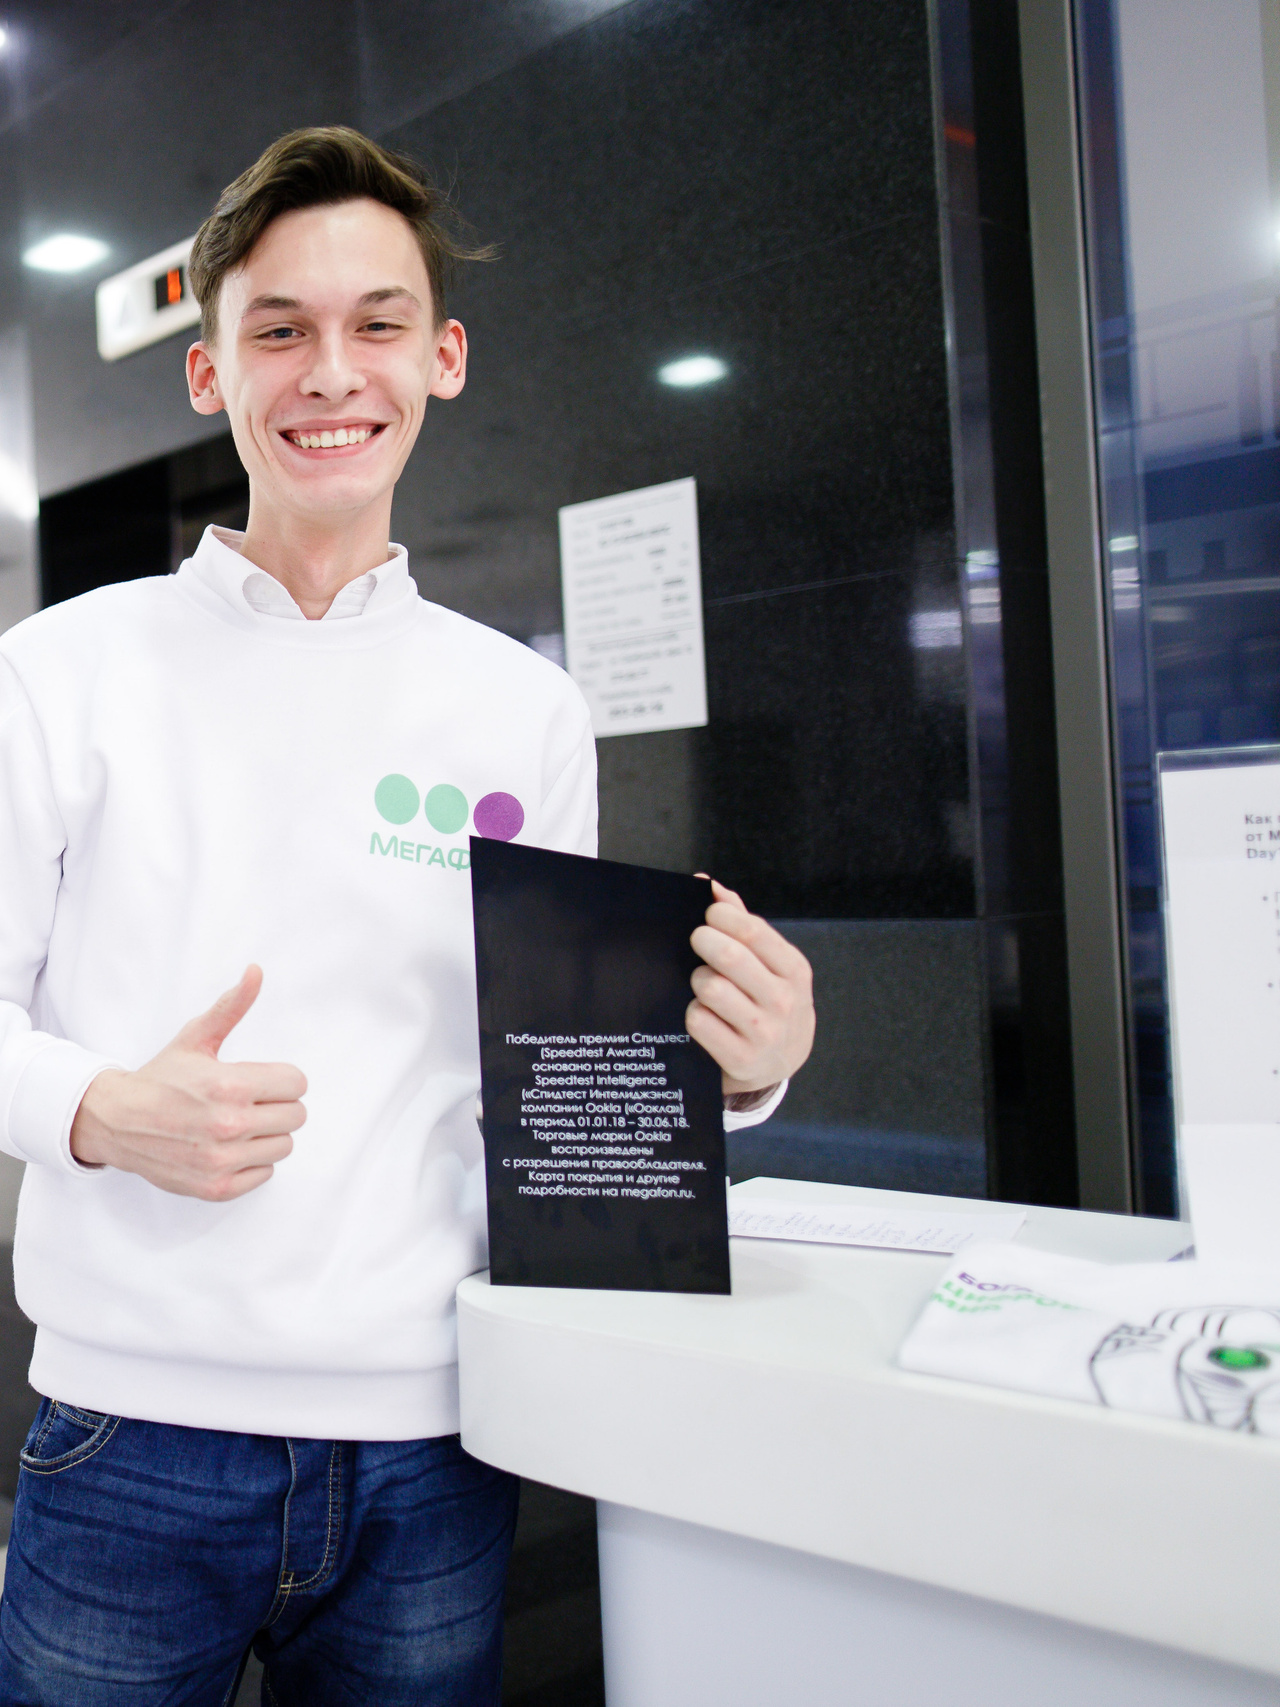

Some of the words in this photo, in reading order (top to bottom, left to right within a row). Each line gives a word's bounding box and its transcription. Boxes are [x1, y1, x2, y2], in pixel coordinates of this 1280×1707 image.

[1245, 814, 1272, 824] Как
[1245, 833, 1264, 842] от
[370, 832, 471, 871] МЕГАФ
[505, 1034, 577, 1044] Победитель
[579, 1035, 629, 1045] премии
[631, 1032, 691, 1043] Спидтест
[540, 1047, 604, 1060] (Speedtest
[606, 1047, 656, 1060] Awards)
[532, 1062, 592, 1072] основано
[594, 1062, 610, 1072] на
[613, 1062, 666, 1072] анализе
[535, 1075, 594, 1087] Speedtest
[596, 1075, 667, 1088] Intelligence
[521, 1104, 583, 1113] компании
[585, 1102, 621, 1114] Ookla
[520, 1118, 527, 1126] в
[529, 1118, 576, 1128] период
[577, 1116, 626, 1127] 01.01.18
[637, 1117, 690, 1128] 30.06.18.
[532, 1129, 588, 1143] Торговые
[590, 1131, 632, 1143] марки
[634, 1130, 672, 1142] Ookla
[551, 1145, 654, 1157] воспроизведены
[502, 1159, 511, 1167] с
[513, 1159, 589, 1169] разрешения
[592, 1159, 707, 1171] правообладателя.
[528, 1170, 565, 1183] Карта
[568, 1173, 623, 1184] покрытия
[625, 1174, 634, 1183] и
[636, 1174, 680, 1185] другие
[518, 1185, 599, 1197] подробности
[602, 1187, 618, 1197] на
[620, 1186, 696, 1200] megafon.ru.
